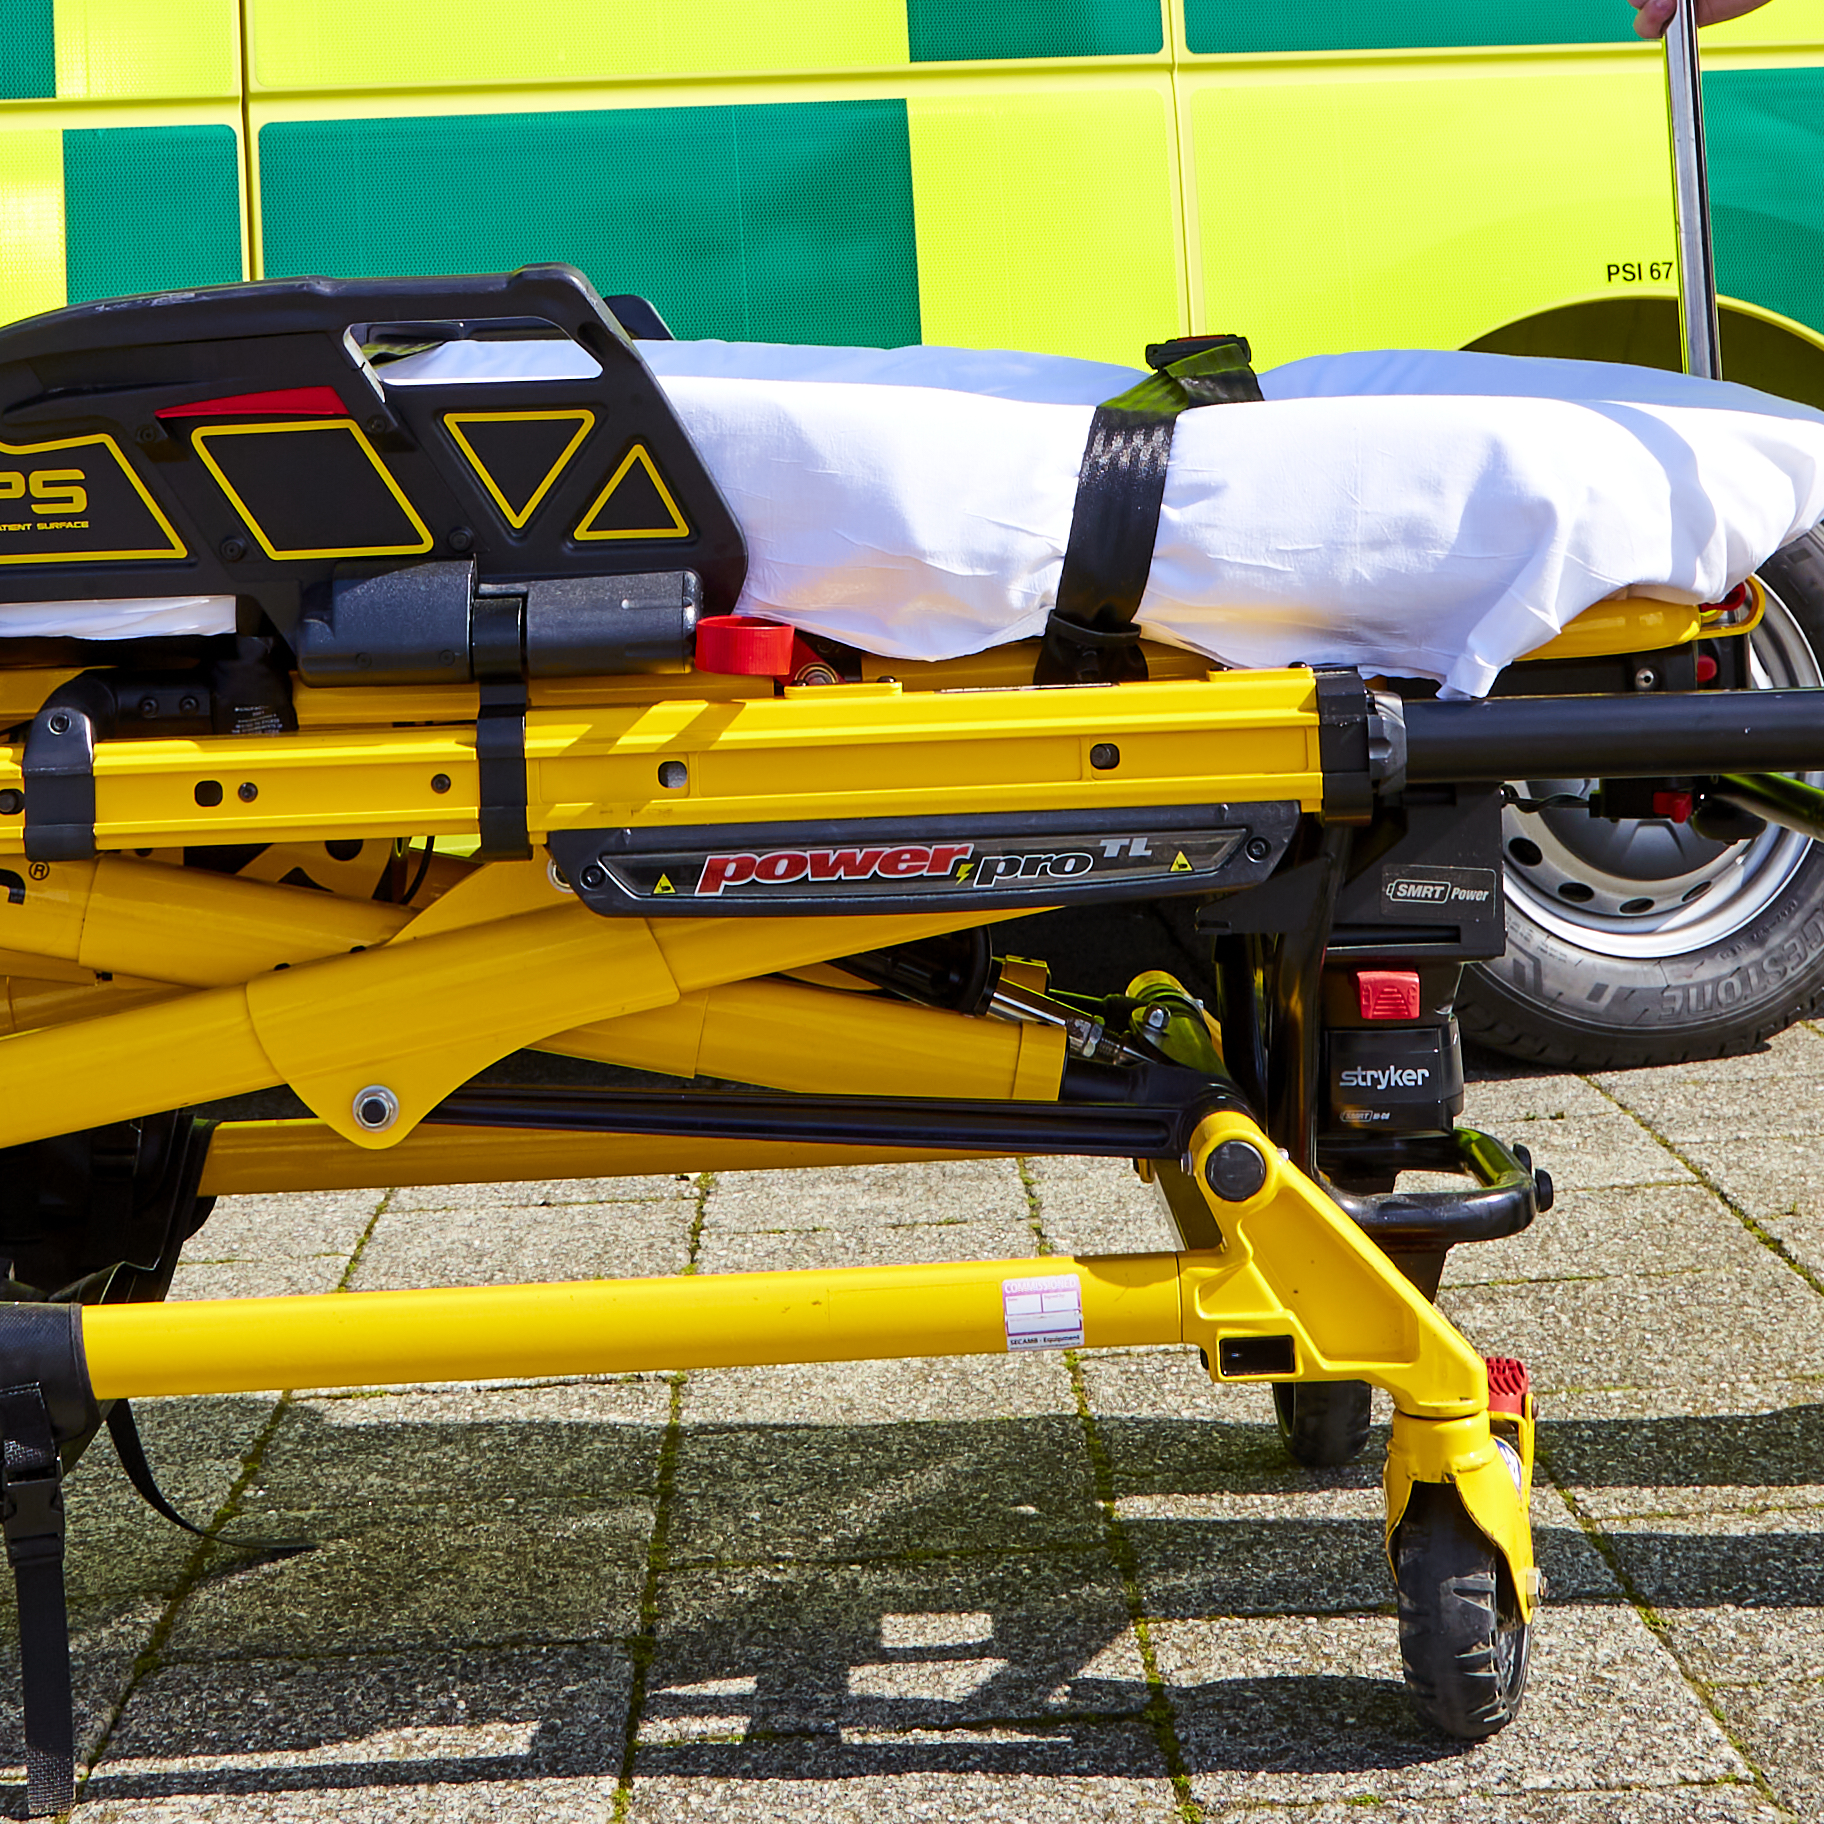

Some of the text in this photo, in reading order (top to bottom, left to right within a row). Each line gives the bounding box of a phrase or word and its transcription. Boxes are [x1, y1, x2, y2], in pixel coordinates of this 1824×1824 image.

[1607, 261, 1674, 283] PSI 67
[37, 521, 89, 531] SURFACE
[1100, 837, 1154, 858] TL
[1397, 883, 1490, 902] SMRT Power
[1339, 1064, 1430, 1090] stryker
[1004, 1277, 1076, 1294] COMMISSIONED
[1043, 1334, 1080, 1344] Equipment
